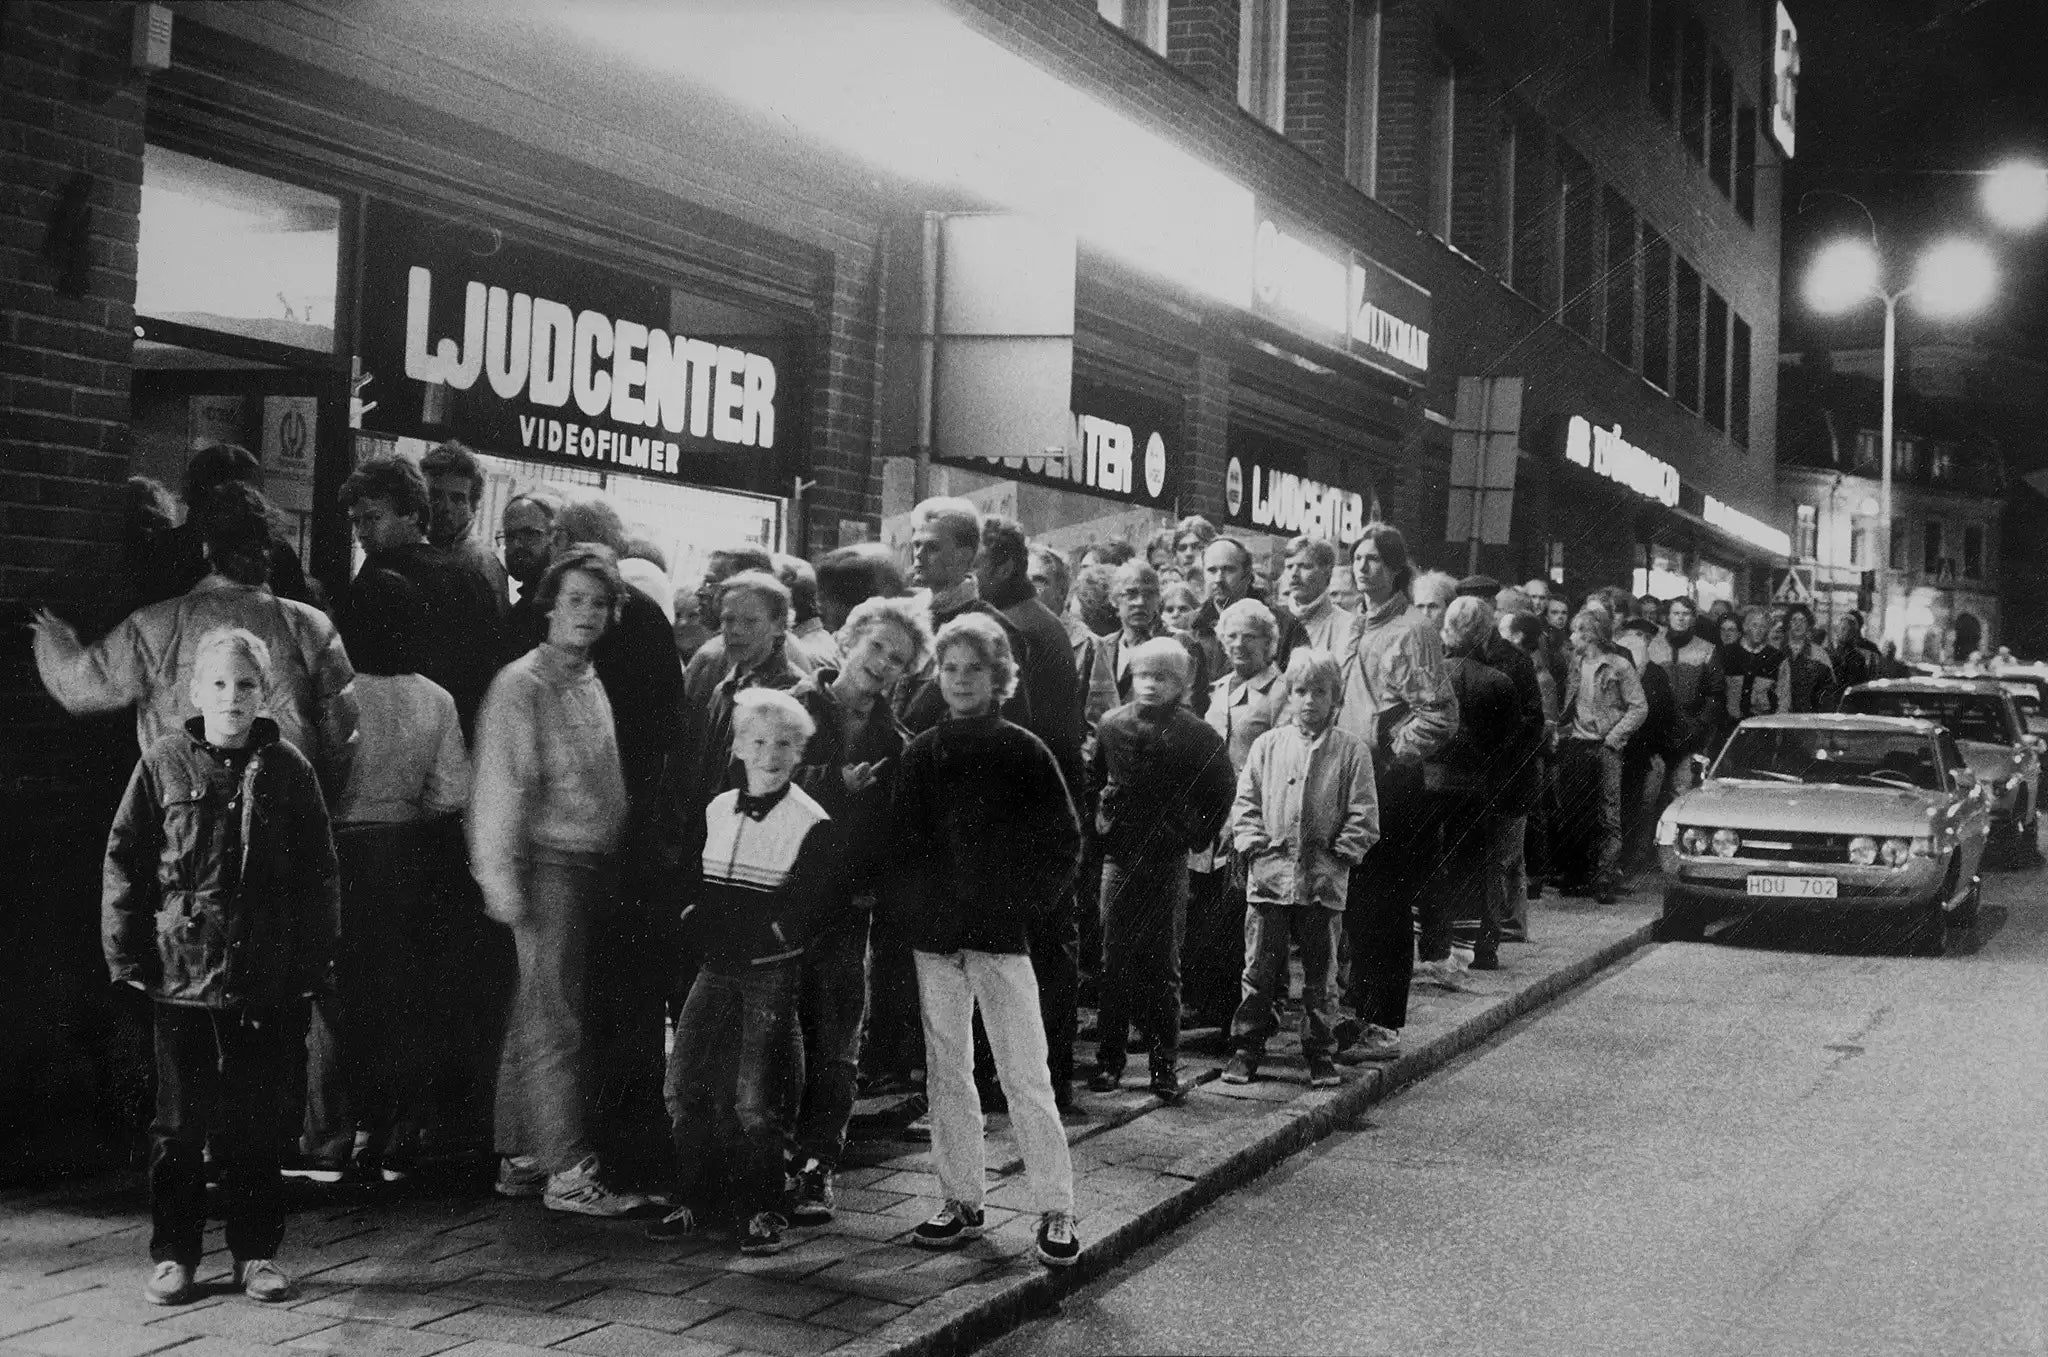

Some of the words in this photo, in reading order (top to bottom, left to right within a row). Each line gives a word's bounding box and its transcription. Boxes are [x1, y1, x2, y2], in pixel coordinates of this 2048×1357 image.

[405, 265, 777, 449] LJUDCENTER
[518, 414, 681, 474] VIDEOFILMER
[1799, 879, 1836, 895] 702
